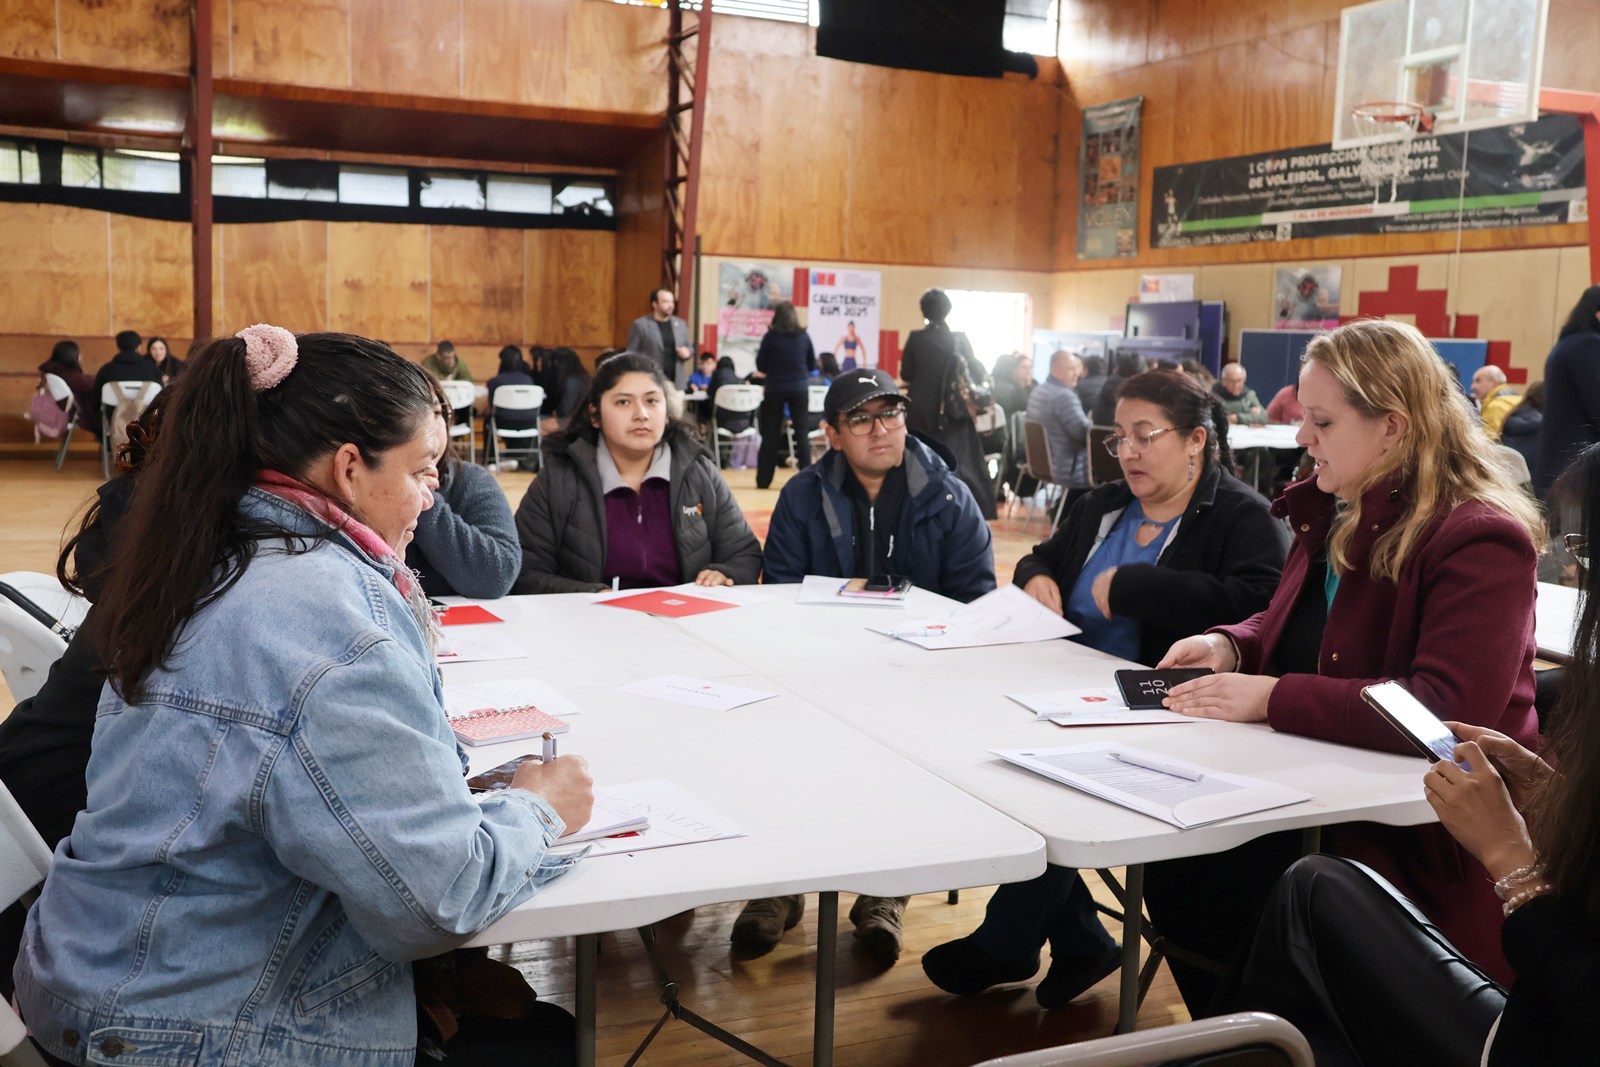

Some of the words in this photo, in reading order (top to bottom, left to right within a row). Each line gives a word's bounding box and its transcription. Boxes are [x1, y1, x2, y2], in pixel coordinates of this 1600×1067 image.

[1248, 176, 1263, 189] DE
[1139, 680, 1154, 695] 11
[1152, 679, 1169, 695] 20
